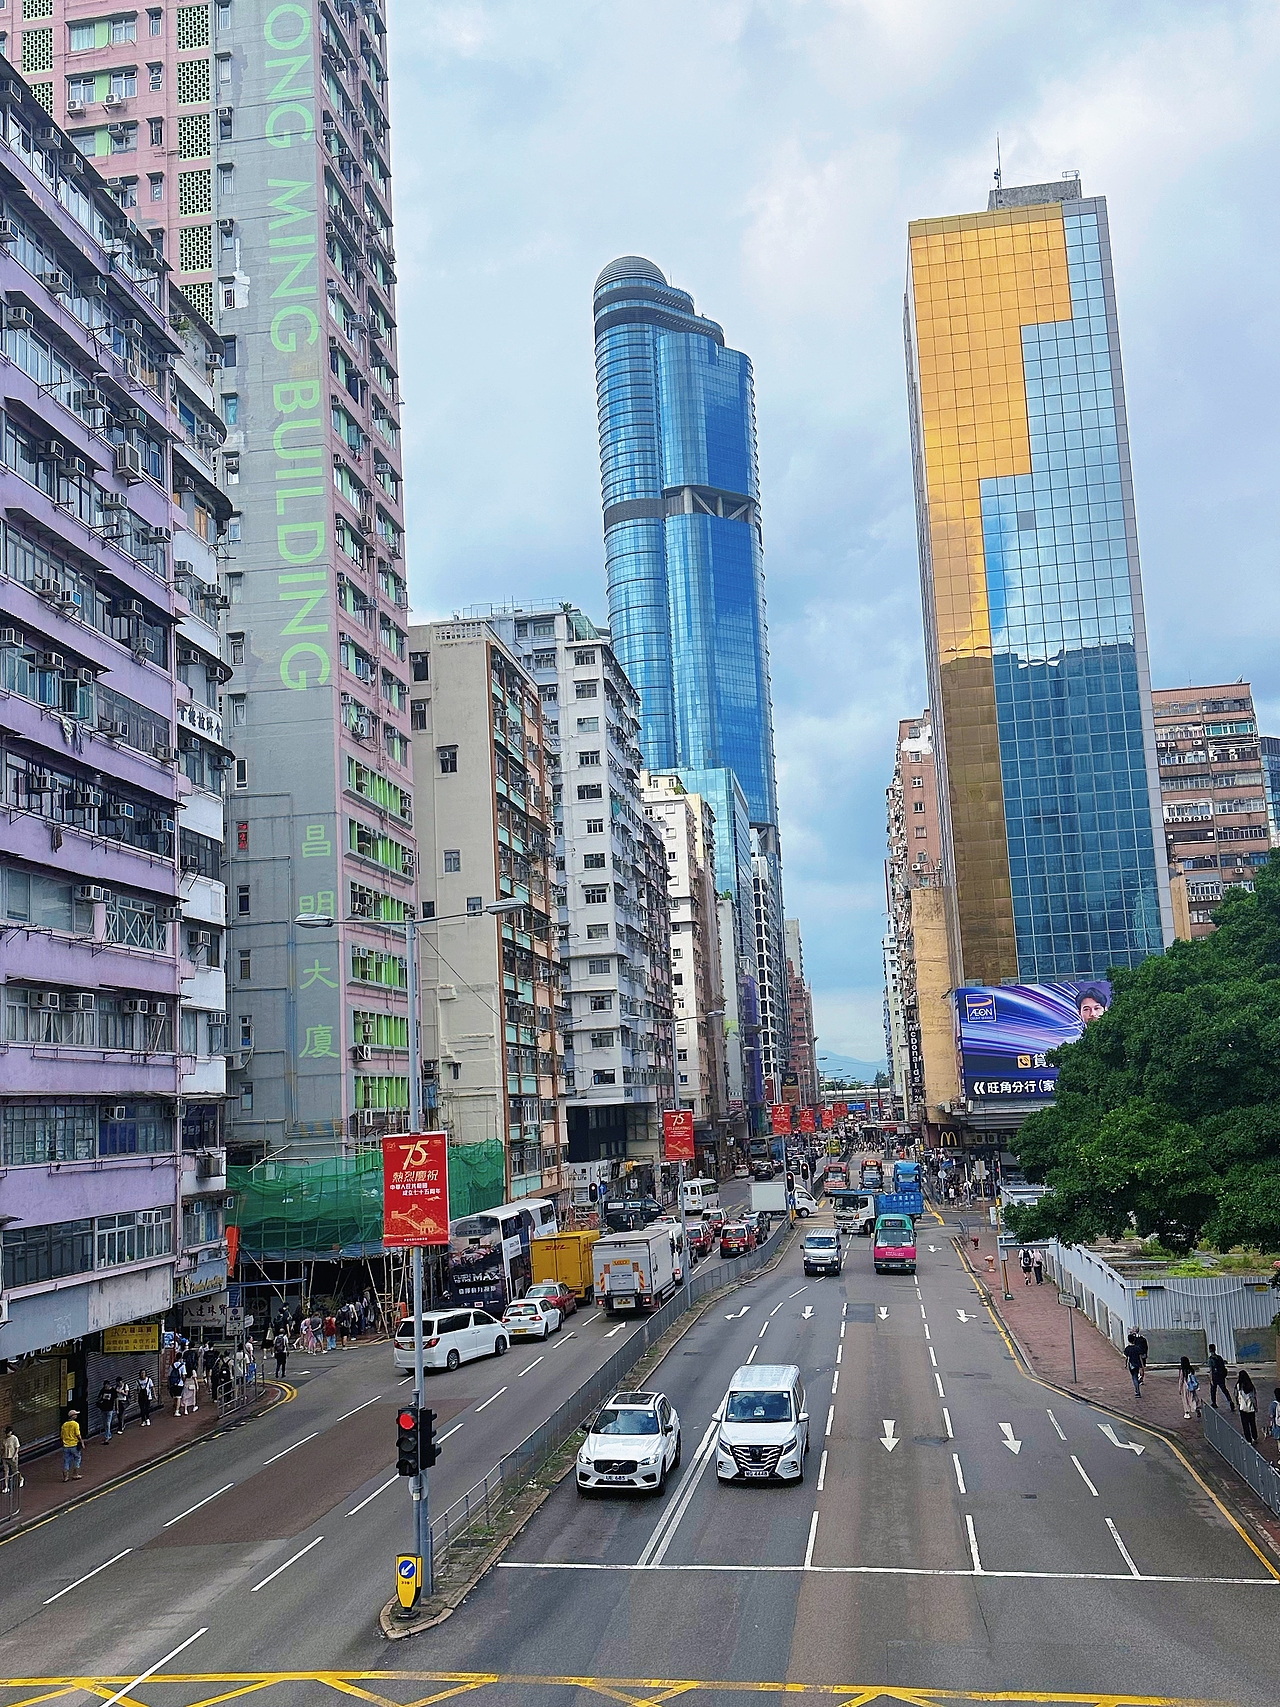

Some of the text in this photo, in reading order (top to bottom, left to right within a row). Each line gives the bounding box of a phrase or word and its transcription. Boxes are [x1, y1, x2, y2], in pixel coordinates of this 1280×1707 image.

[266, 178, 319, 353] MING
[272, 379, 331, 691] BUILDING
[298, 824, 340, 1059] 昌明大廈
[908, 1024, 921, 1083] McDonald's
[671, 1113, 685, 1126] 75
[776, 1106, 785, 1114] 75
[399, 1140, 430, 1170] 75
[392, 1169, 439, 1183] 熱烈慶祝
[473, 1272, 500, 1282] MAX
